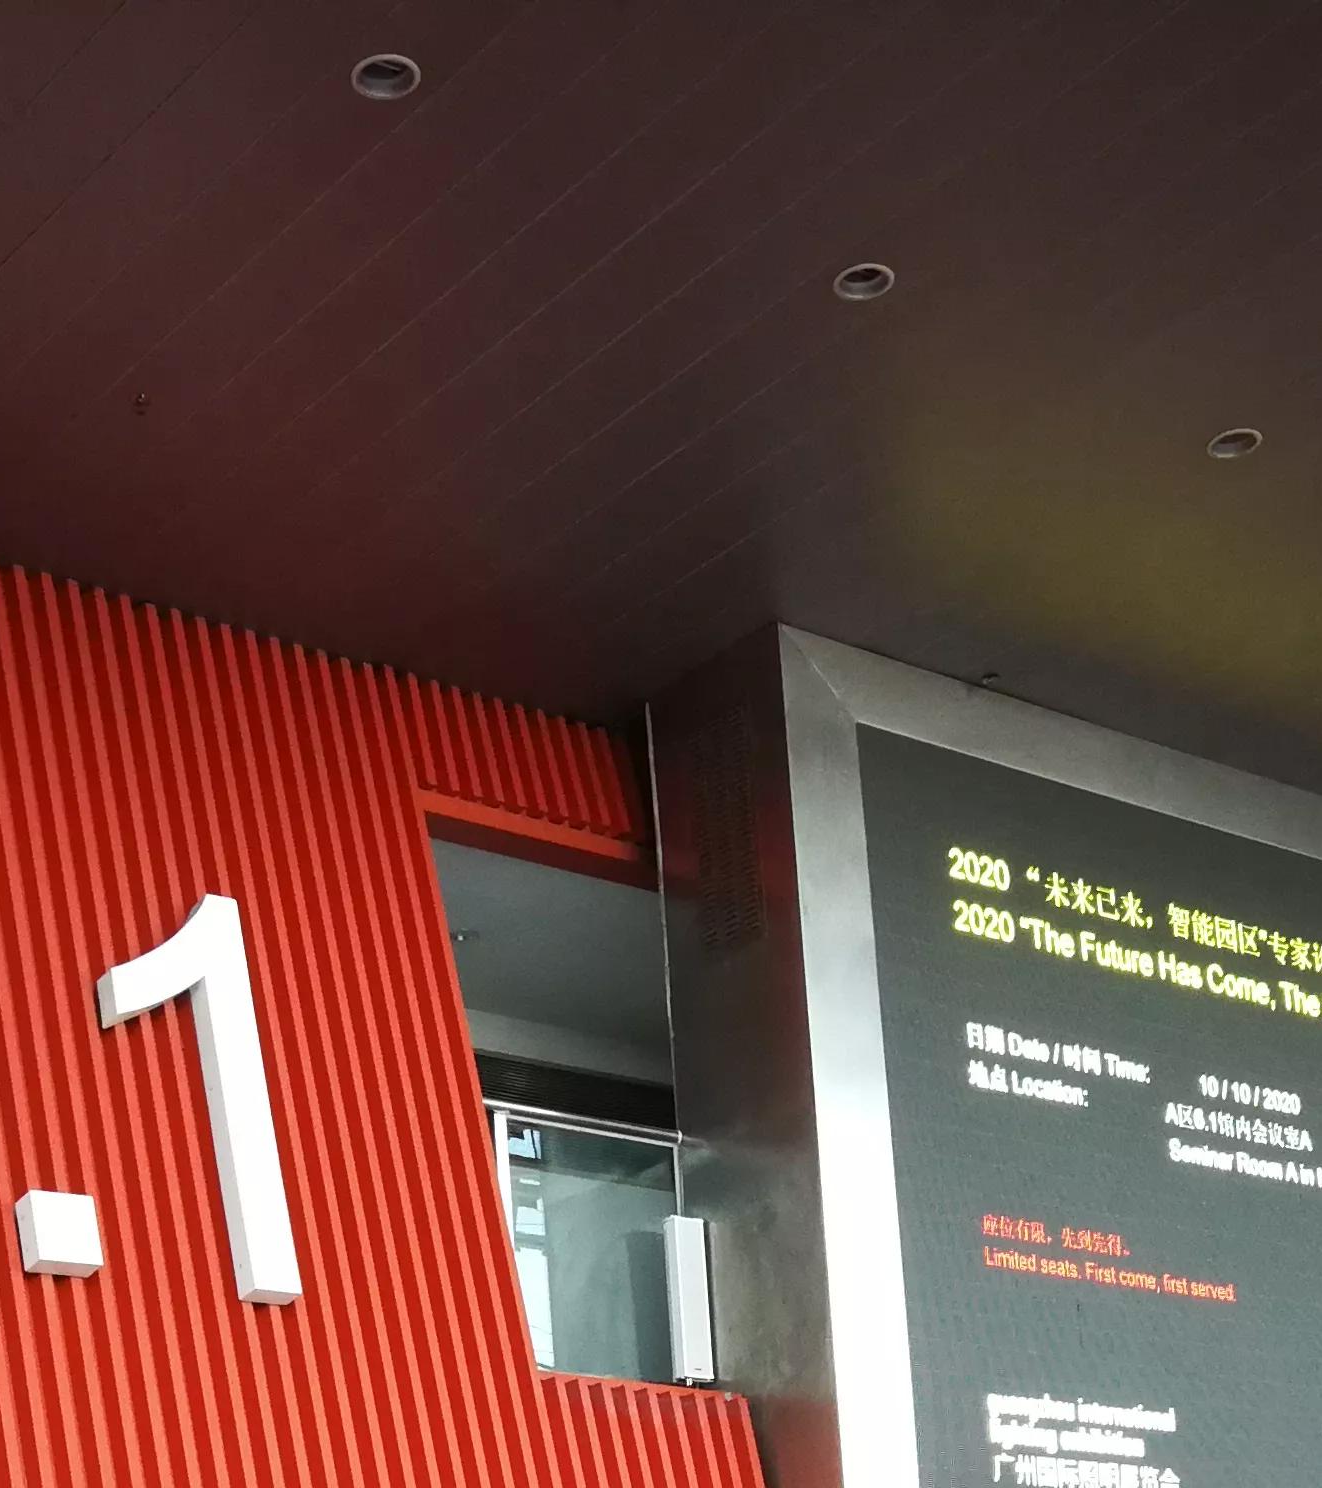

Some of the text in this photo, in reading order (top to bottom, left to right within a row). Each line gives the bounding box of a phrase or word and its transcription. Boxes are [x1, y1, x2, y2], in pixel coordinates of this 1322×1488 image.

[948, 846, 1011, 891] 2020
[953, 899, 1015, 943] 2020
[1080, 930, 1155, 977] Future
[1158, 951, 1203, 989] Has
[1206, 963, 1276, 1010] Come,
[1278, 980, 1320, 1017] The
[1011, 1070, 1088, 1107] Location:
[1236, 1152, 1283, 1180] Room
[1285, 1161, 1299, 1184] A
[984, 1246, 1037, 1273] Limited
[1040, 1259, 1082, 1280] seats.
[1085, 1262, 1117, 1284] First
[1119, 1270, 1161, 1294] come,
[1163, 1274, 1188, 1295] first
